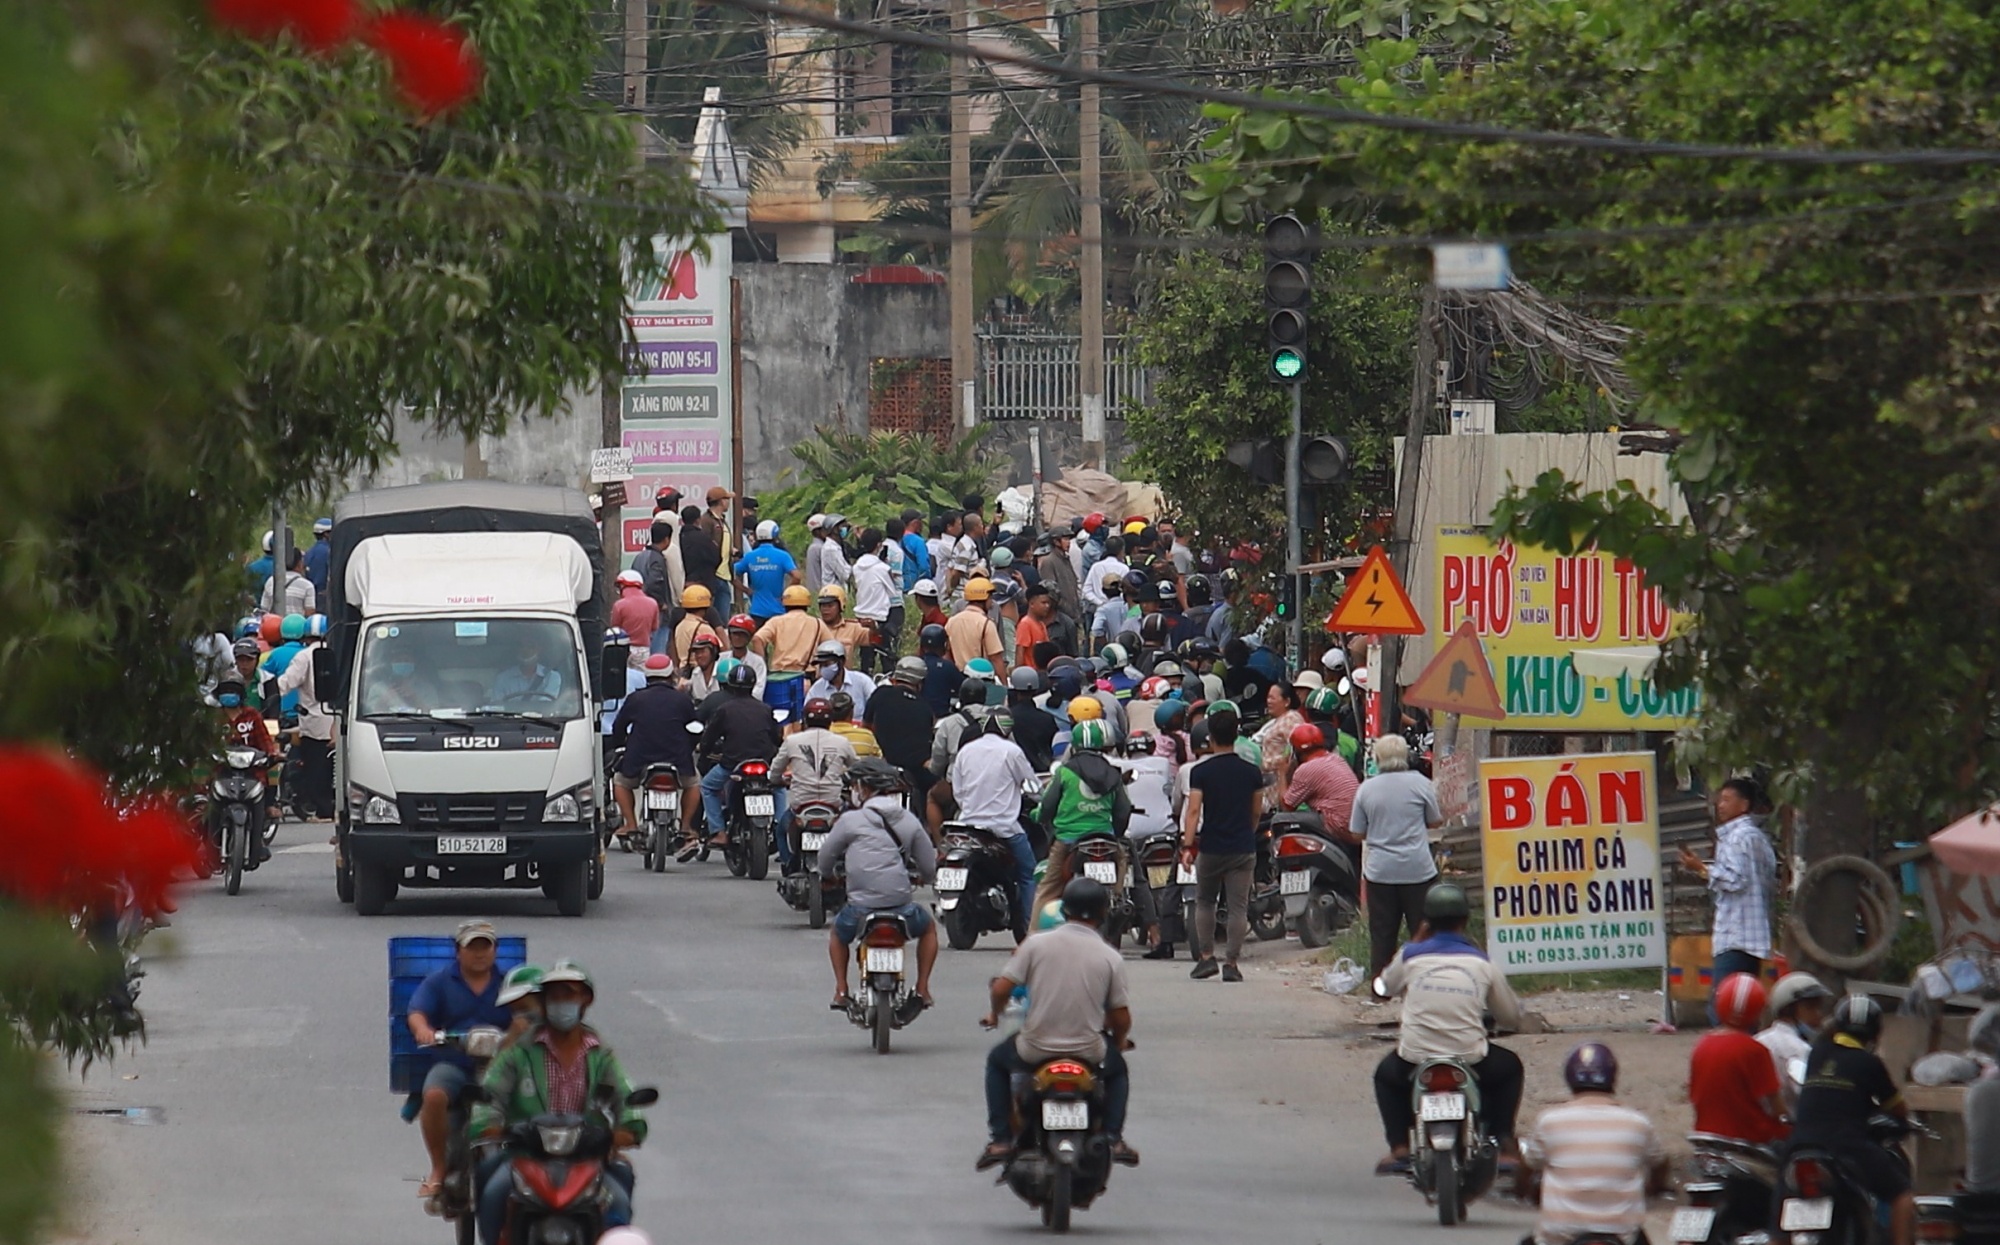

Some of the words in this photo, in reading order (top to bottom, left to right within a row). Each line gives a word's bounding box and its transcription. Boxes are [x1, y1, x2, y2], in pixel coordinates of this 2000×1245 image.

[654, 317, 675, 326] NAM
[677, 317, 708, 325] PETRO
[661, 350, 684, 369] RON
[686, 350, 711, 368] 95-II
[632, 393, 660, 413] XĂNG
[662, 395, 683, 412] RON
[686, 395, 710, 412] 92-II
[660, 441, 673, 457] E5
[676, 440, 696, 457] RON
[699, 440, 714, 457] 92
[443, 736, 500, 749] ISUZU
[1487, 762, 1646, 831] BÁN
[1517, 838, 1586, 873] CHIM
[1492, 877, 1579, 918] PHÓNG
[1587, 878, 1655, 914] SANH
[1497, 927, 1536, 944] GIAO
[1542, 922, 1585, 942] HÀNG
[1626, 920, 1655, 938] NƠI
[1508, 950, 1533, 965] LH:
[1537, 943, 1647, 962] 0933.301.370
